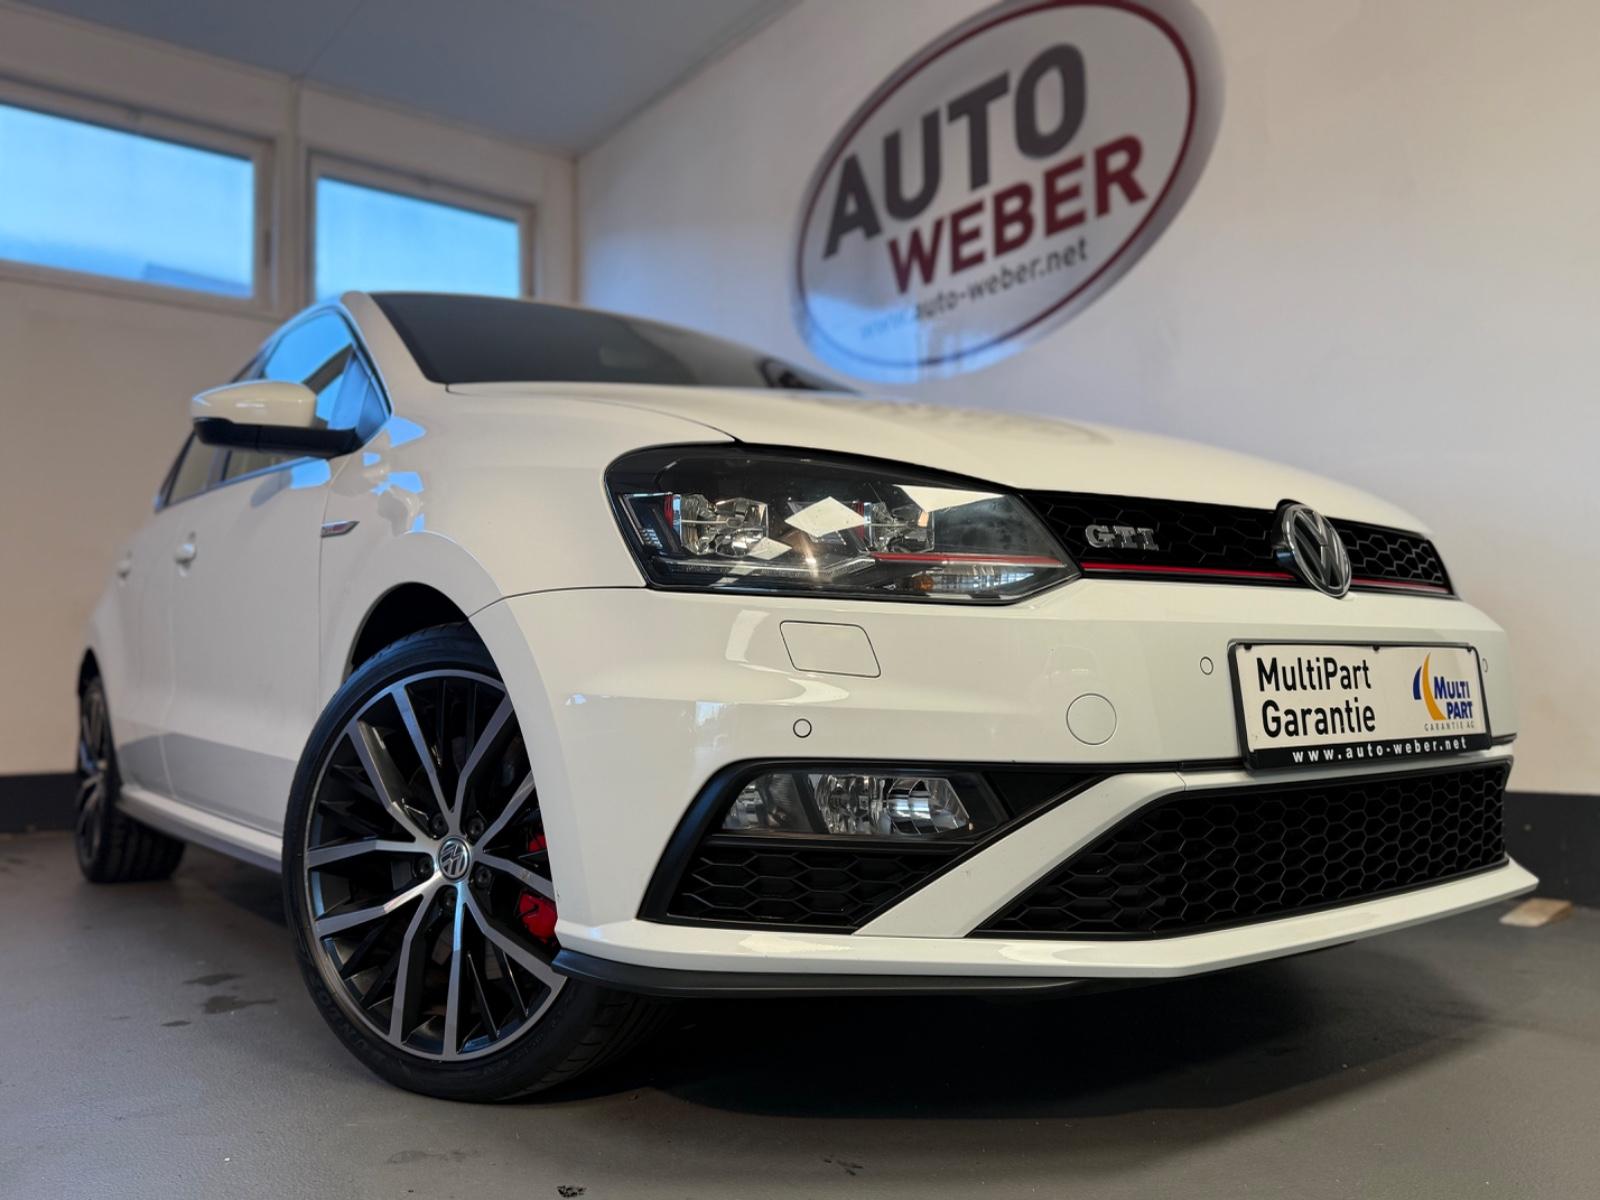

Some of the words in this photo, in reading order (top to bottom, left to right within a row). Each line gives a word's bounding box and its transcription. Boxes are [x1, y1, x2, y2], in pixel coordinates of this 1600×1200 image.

[824, 43, 1087, 260] AUTO
[888, 134, 1148, 296] WEBER
[860, 235, 1089, 341] www.auto-weber.net
[1085, 524, 1159, 551] GTI
[1256, 657, 1372, 692] MultiPart
[1434, 676, 1470, 699] MULTI
[1262, 697, 1376, 738] Garantie
[1424, 720, 1464, 731] GARANTIE
[1446, 701, 1473, 720] PART
[1293, 736, 1467, 763] www.auto-weber.net
